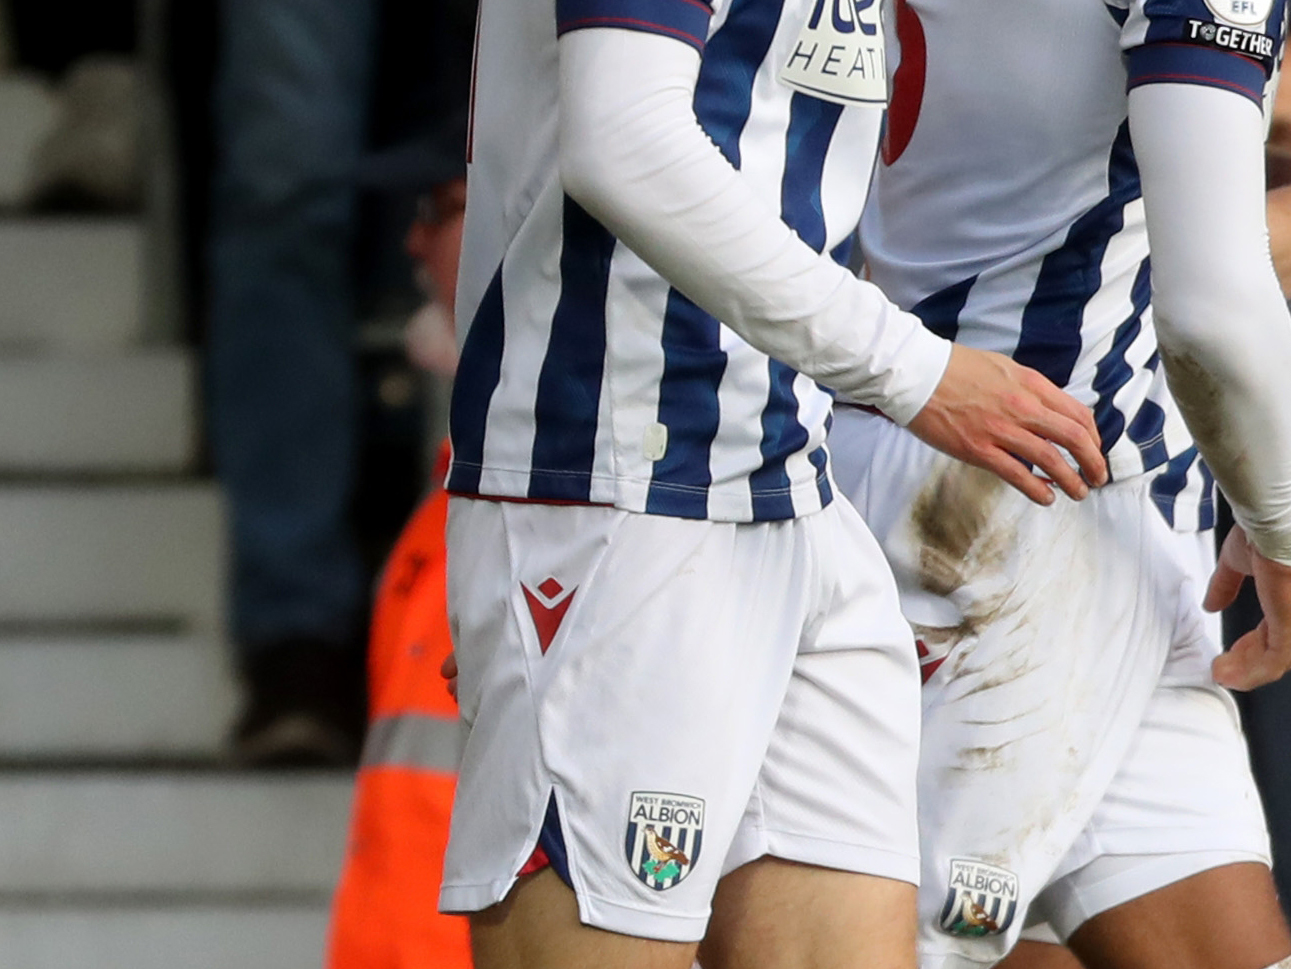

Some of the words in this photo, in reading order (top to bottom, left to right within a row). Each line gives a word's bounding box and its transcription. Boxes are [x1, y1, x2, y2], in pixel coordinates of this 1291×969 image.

[1232, 0, 1257, 15] EFL
[635, 795, 659, 805] WEST
[634, 804, 701, 825] ALBION
[952, 871, 1016, 898] ALBION
